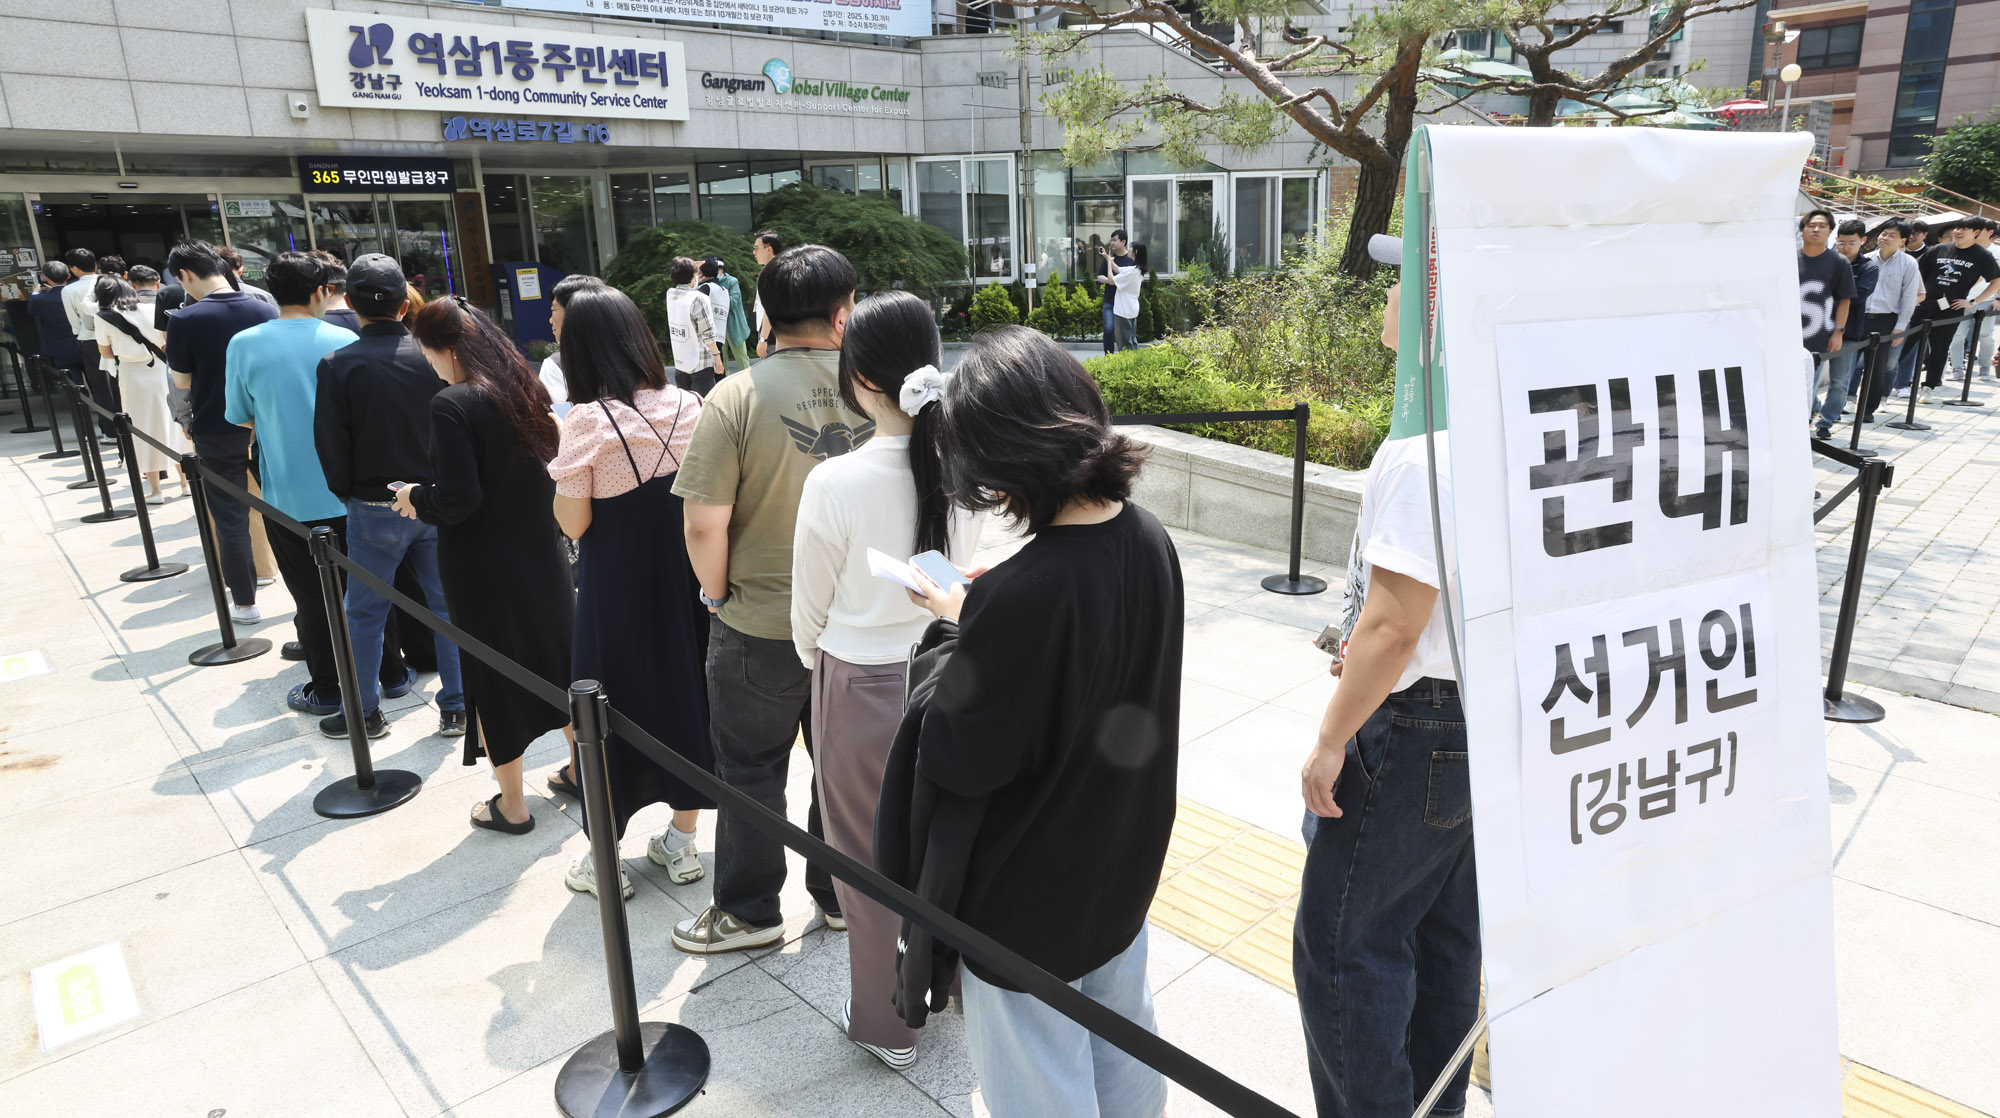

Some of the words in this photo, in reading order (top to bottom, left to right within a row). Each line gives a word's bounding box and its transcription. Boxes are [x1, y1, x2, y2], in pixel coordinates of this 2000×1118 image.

[407, 32, 670, 88] 역삼1동주민센터
[348, 72, 403, 91] 강남구
[415, 81, 472, 99] Yeoksam
[476, 85, 520, 104] 1-dong
[522, 87, 587, 108] Community
[590, 91, 631, 107] Service
[633, 94, 668, 109] Center
[701, 71, 766, 94] Gangnam
[825, 81, 869, 103] Village
[871, 85, 911, 103] Center
[841, 103, 870, 113] Center
[469, 117, 574, 144] 역삼로7길
[584, 122, 611, 143] 16
[312, 170, 340, 184] 365
[343, 169, 449, 185] 무인민원발급창구
[796, 399, 839, 412] RESPONSE
[811, 387, 842, 398] SPECIA
[1528, 366, 1750, 558] 관내
[1541, 602, 1758, 755] 선거인
